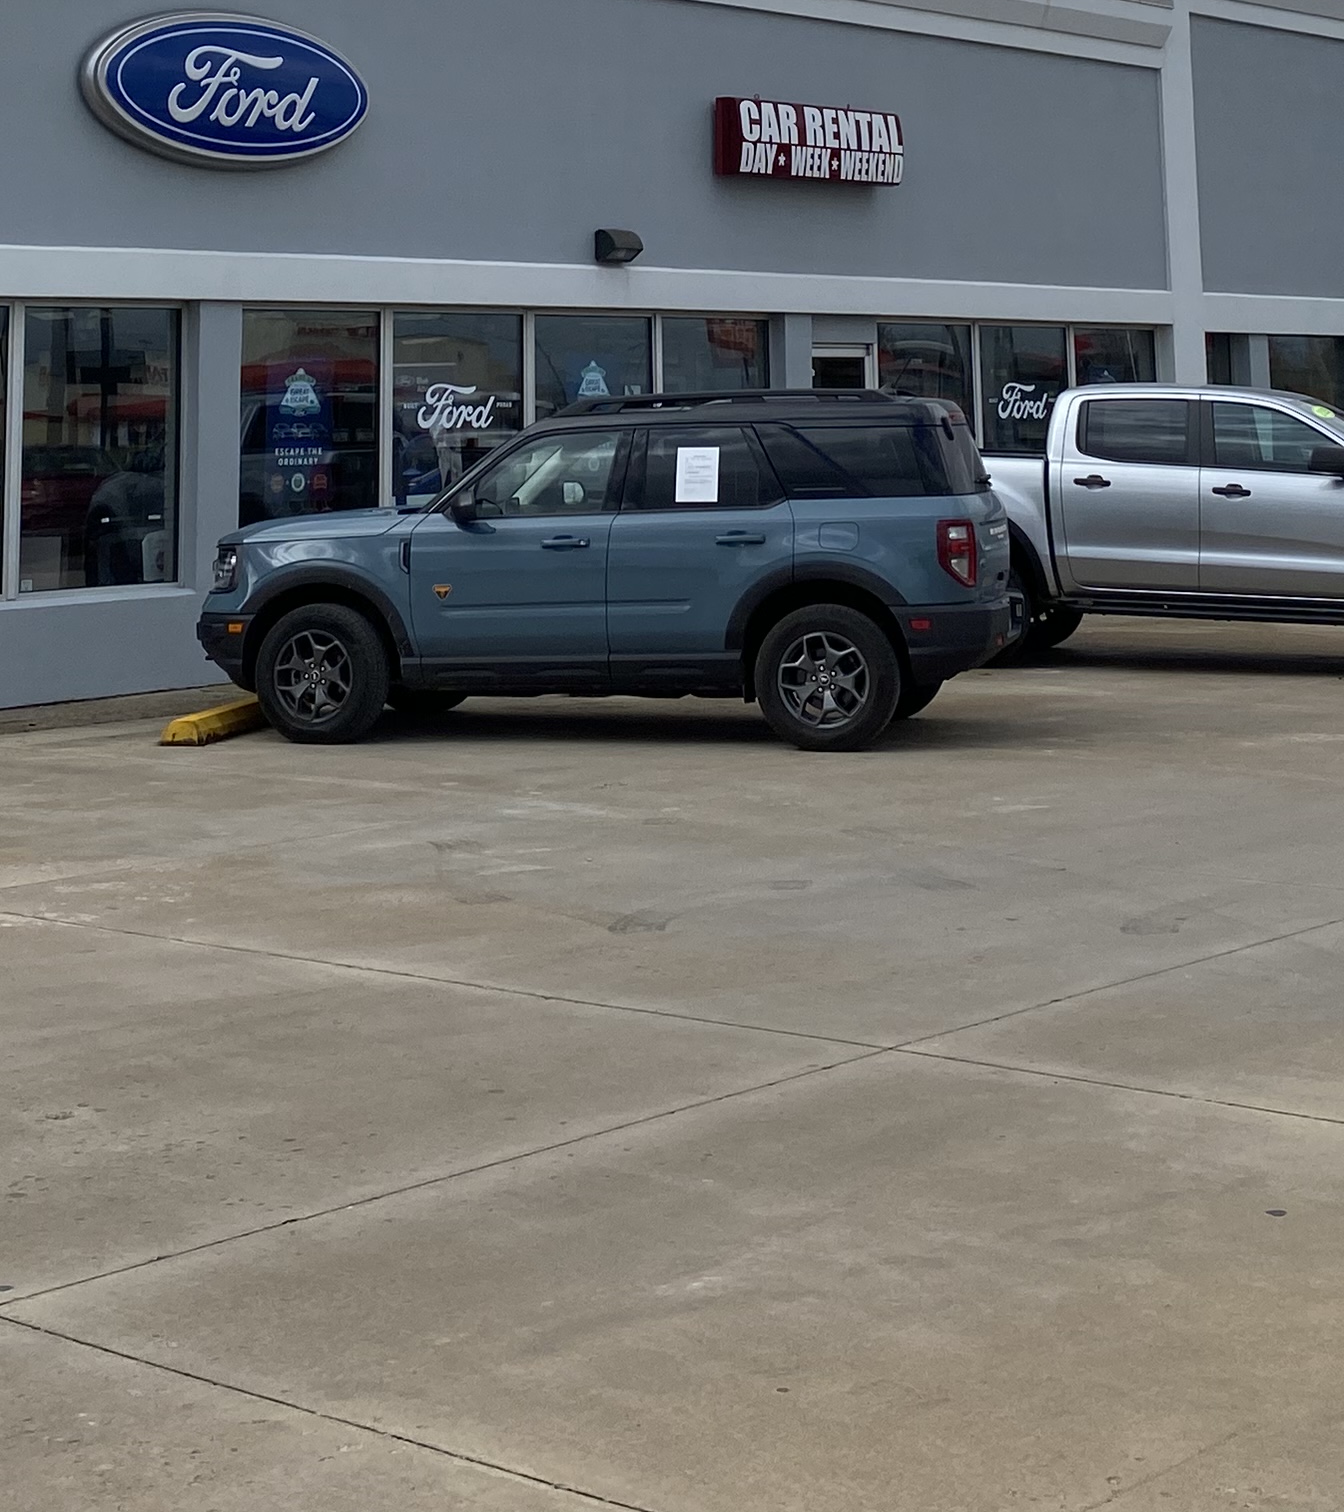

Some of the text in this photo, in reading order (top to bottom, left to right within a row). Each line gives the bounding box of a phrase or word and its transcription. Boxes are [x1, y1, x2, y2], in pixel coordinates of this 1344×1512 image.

[167, 44, 320, 132] Ford
[739, 99, 904, 154] CAR RENTAL
[739, 141, 904, 184] DAY WEEK WEEKEND
[417, 383, 495, 429] Ford
[998, 382, 1048, 419] Ford
[275, 447, 323, 456] ESCAPE THE
[278, 458, 318, 466] ORDINARY
